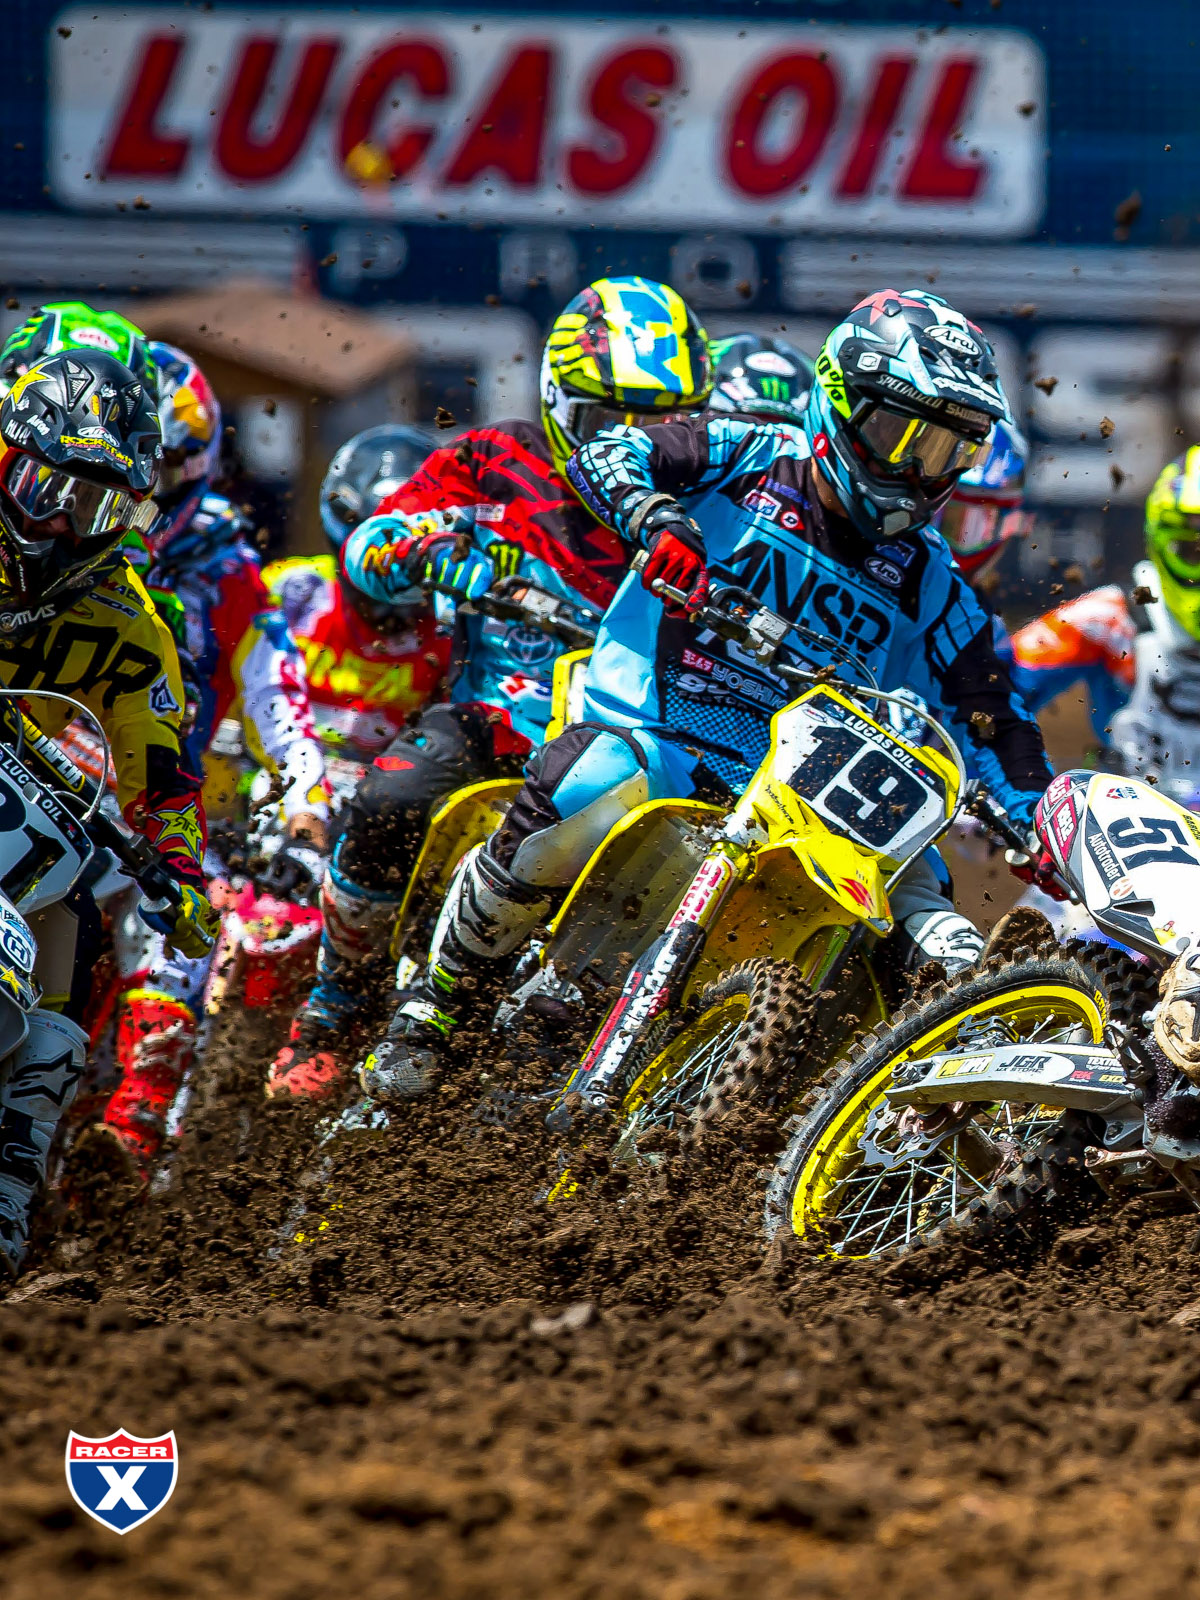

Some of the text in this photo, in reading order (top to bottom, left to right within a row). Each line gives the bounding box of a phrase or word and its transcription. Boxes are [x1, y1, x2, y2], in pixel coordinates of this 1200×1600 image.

[103, 35, 988, 202] LUCAS OIL
[942, 329, 977, 353] Arai
[876, 375, 944, 409] SPECIALIZED
[60, 435, 134, 467] ROCKSTAR
[872, 560, 899, 585] Arai
[9, 603, 56, 627] ATLAS
[843, 715, 893, 750] LUCAS
[891, 746, 914, 770] OIL
[2, 758, 65, 822] LUCS OIL
[786, 725, 928, 847] 19
[1087, 832, 1121, 881] Autotrader
[1106, 817, 1200, 870] 51
[1000, 1055, 1052, 1069] JGR
[1070, 1070, 1094, 1080] RK
